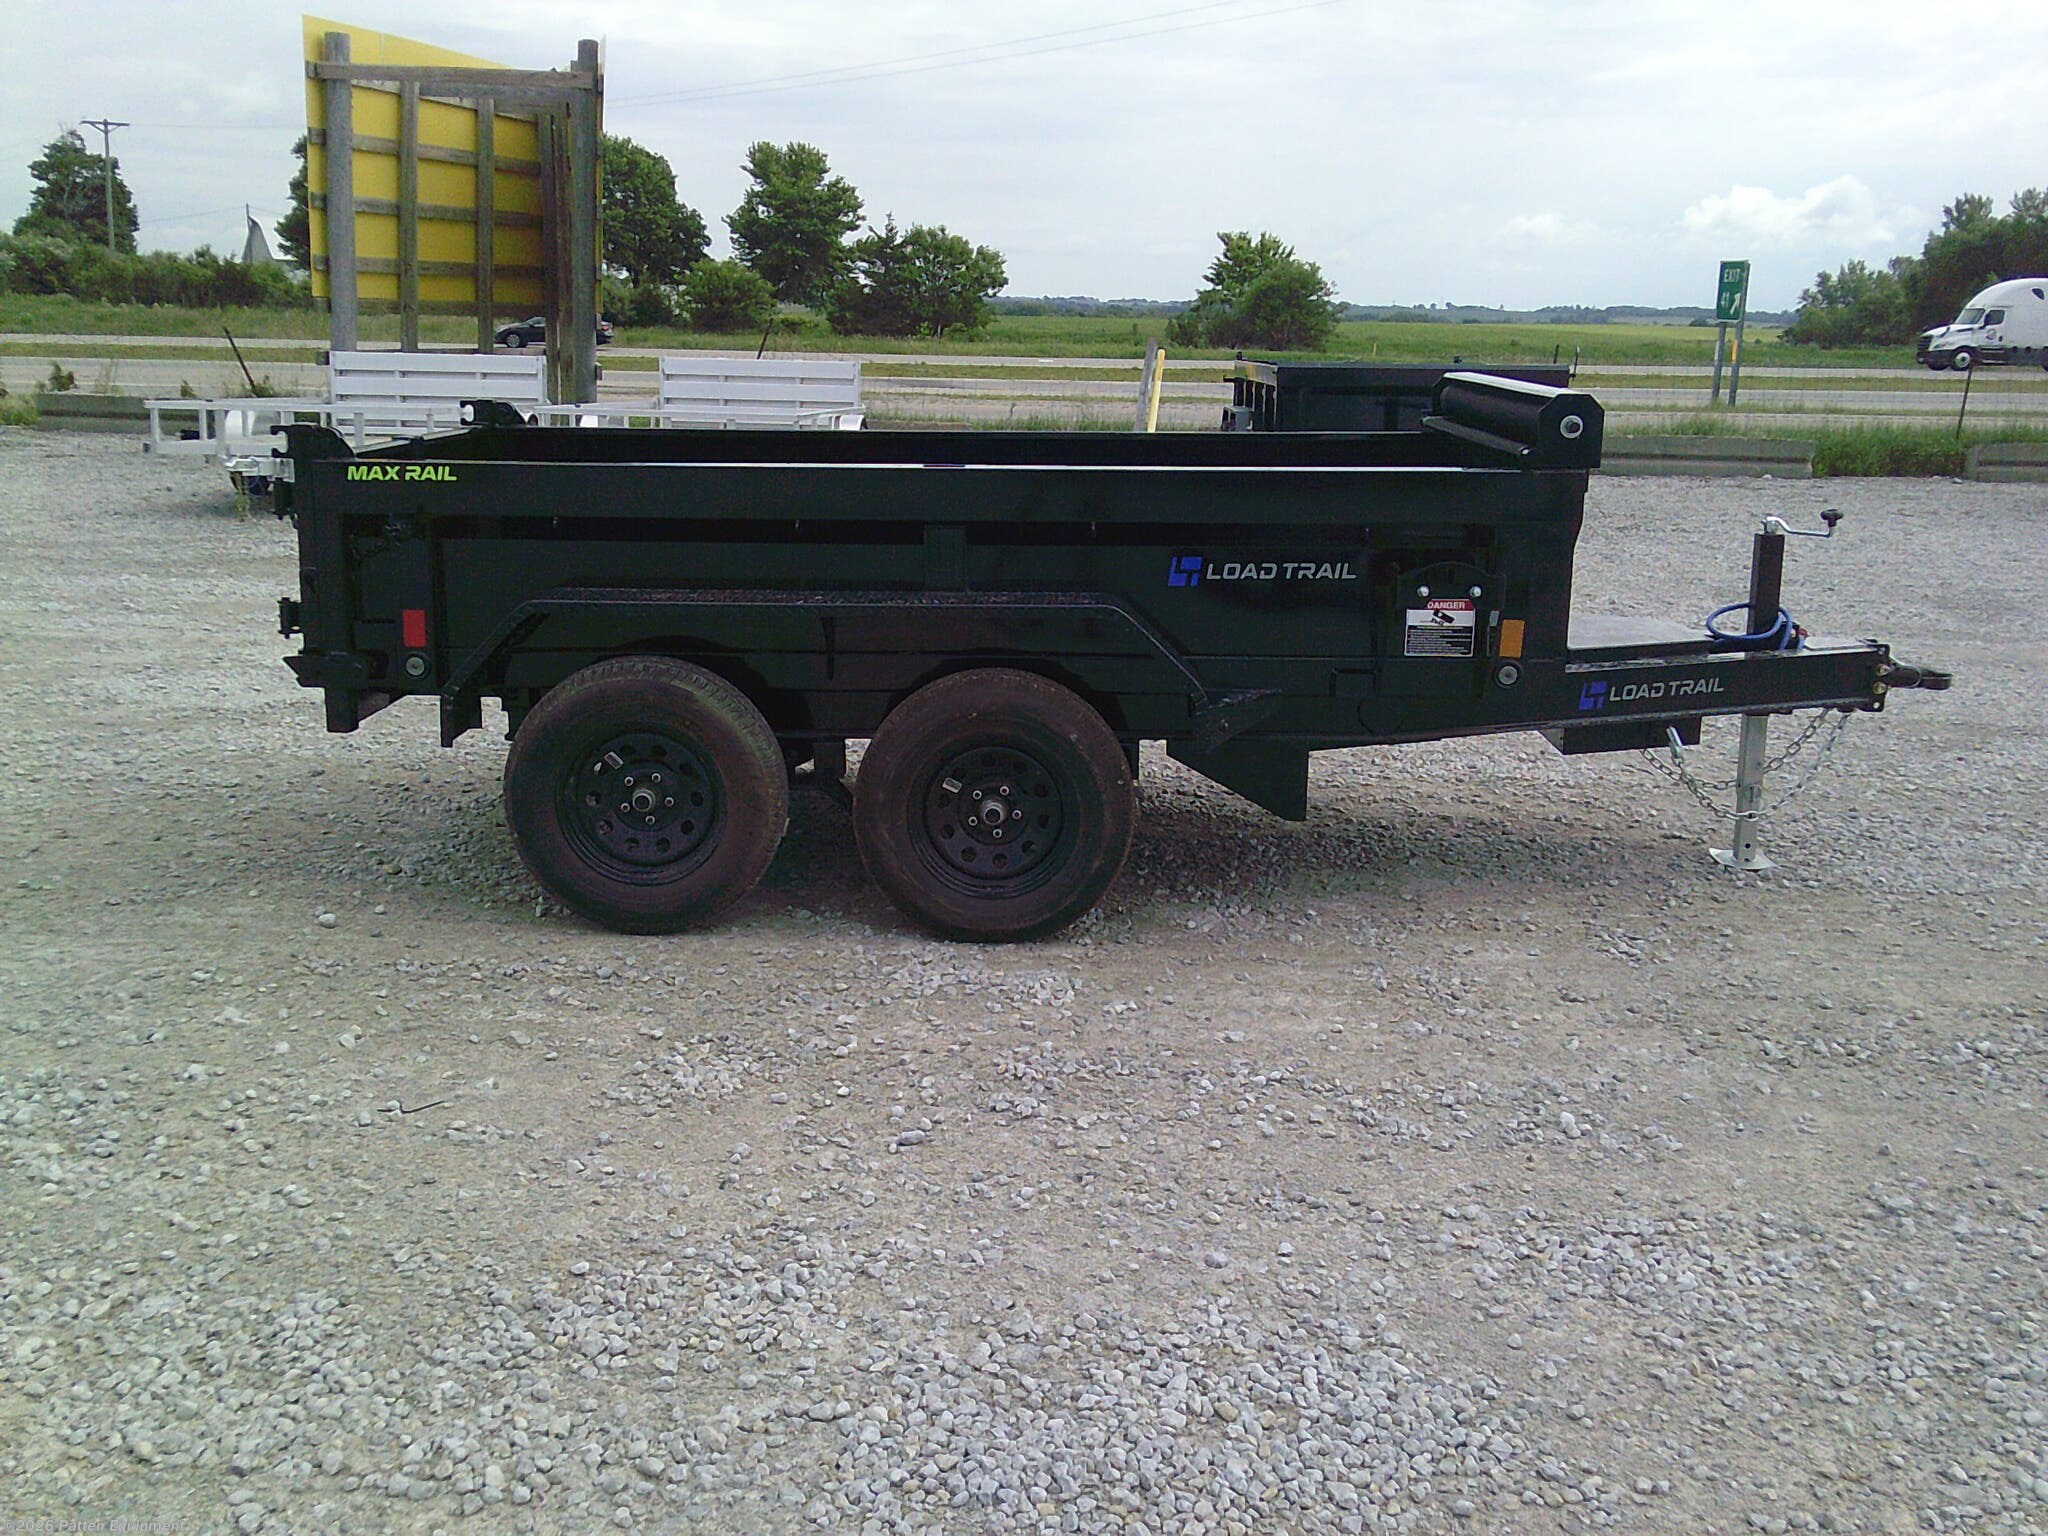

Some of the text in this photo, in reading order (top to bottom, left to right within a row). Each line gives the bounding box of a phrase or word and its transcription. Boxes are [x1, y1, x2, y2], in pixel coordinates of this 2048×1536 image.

[347, 465, 458, 481] MAX RAIL
[1206, 562, 1278, 580] LOAD
[1282, 562, 1357, 580] TRAIL
[1427, 601, 1466, 609] DANGER
[1609, 683, 1666, 702] LOAD
[1667, 677, 1725, 697] TRAIL
